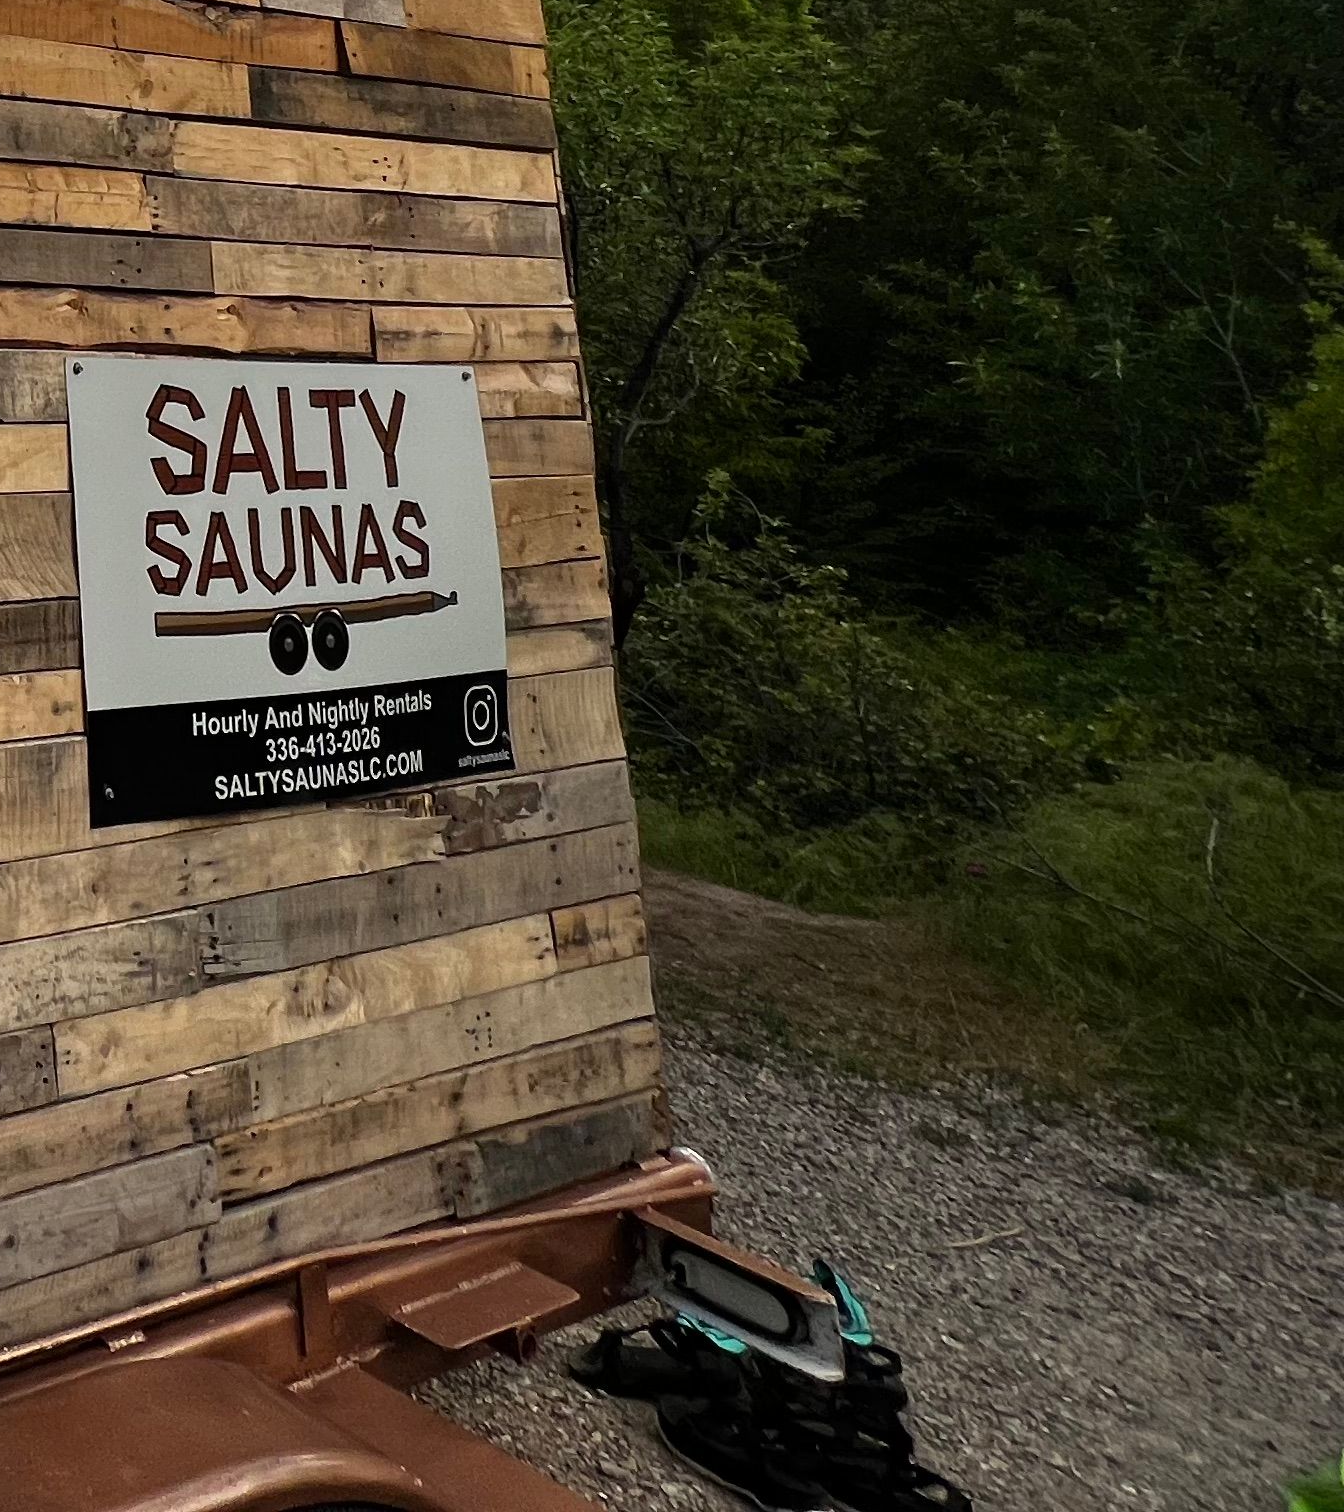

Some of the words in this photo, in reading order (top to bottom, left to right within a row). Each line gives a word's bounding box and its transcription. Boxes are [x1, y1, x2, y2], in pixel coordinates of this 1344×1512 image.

[146, 384, 406, 495] SALTY
[146, 500, 429, 596] SAUNAS
[192, 708, 259, 738] Hourly
[264, 703, 303, 730] And
[307, 697, 369, 729] Nightly
[373, 689, 432, 718] Rentals
[265, 726, 381, 762] 336-413-2026
[214, 749, 424, 800] SALTYSAUNASLC.COM
